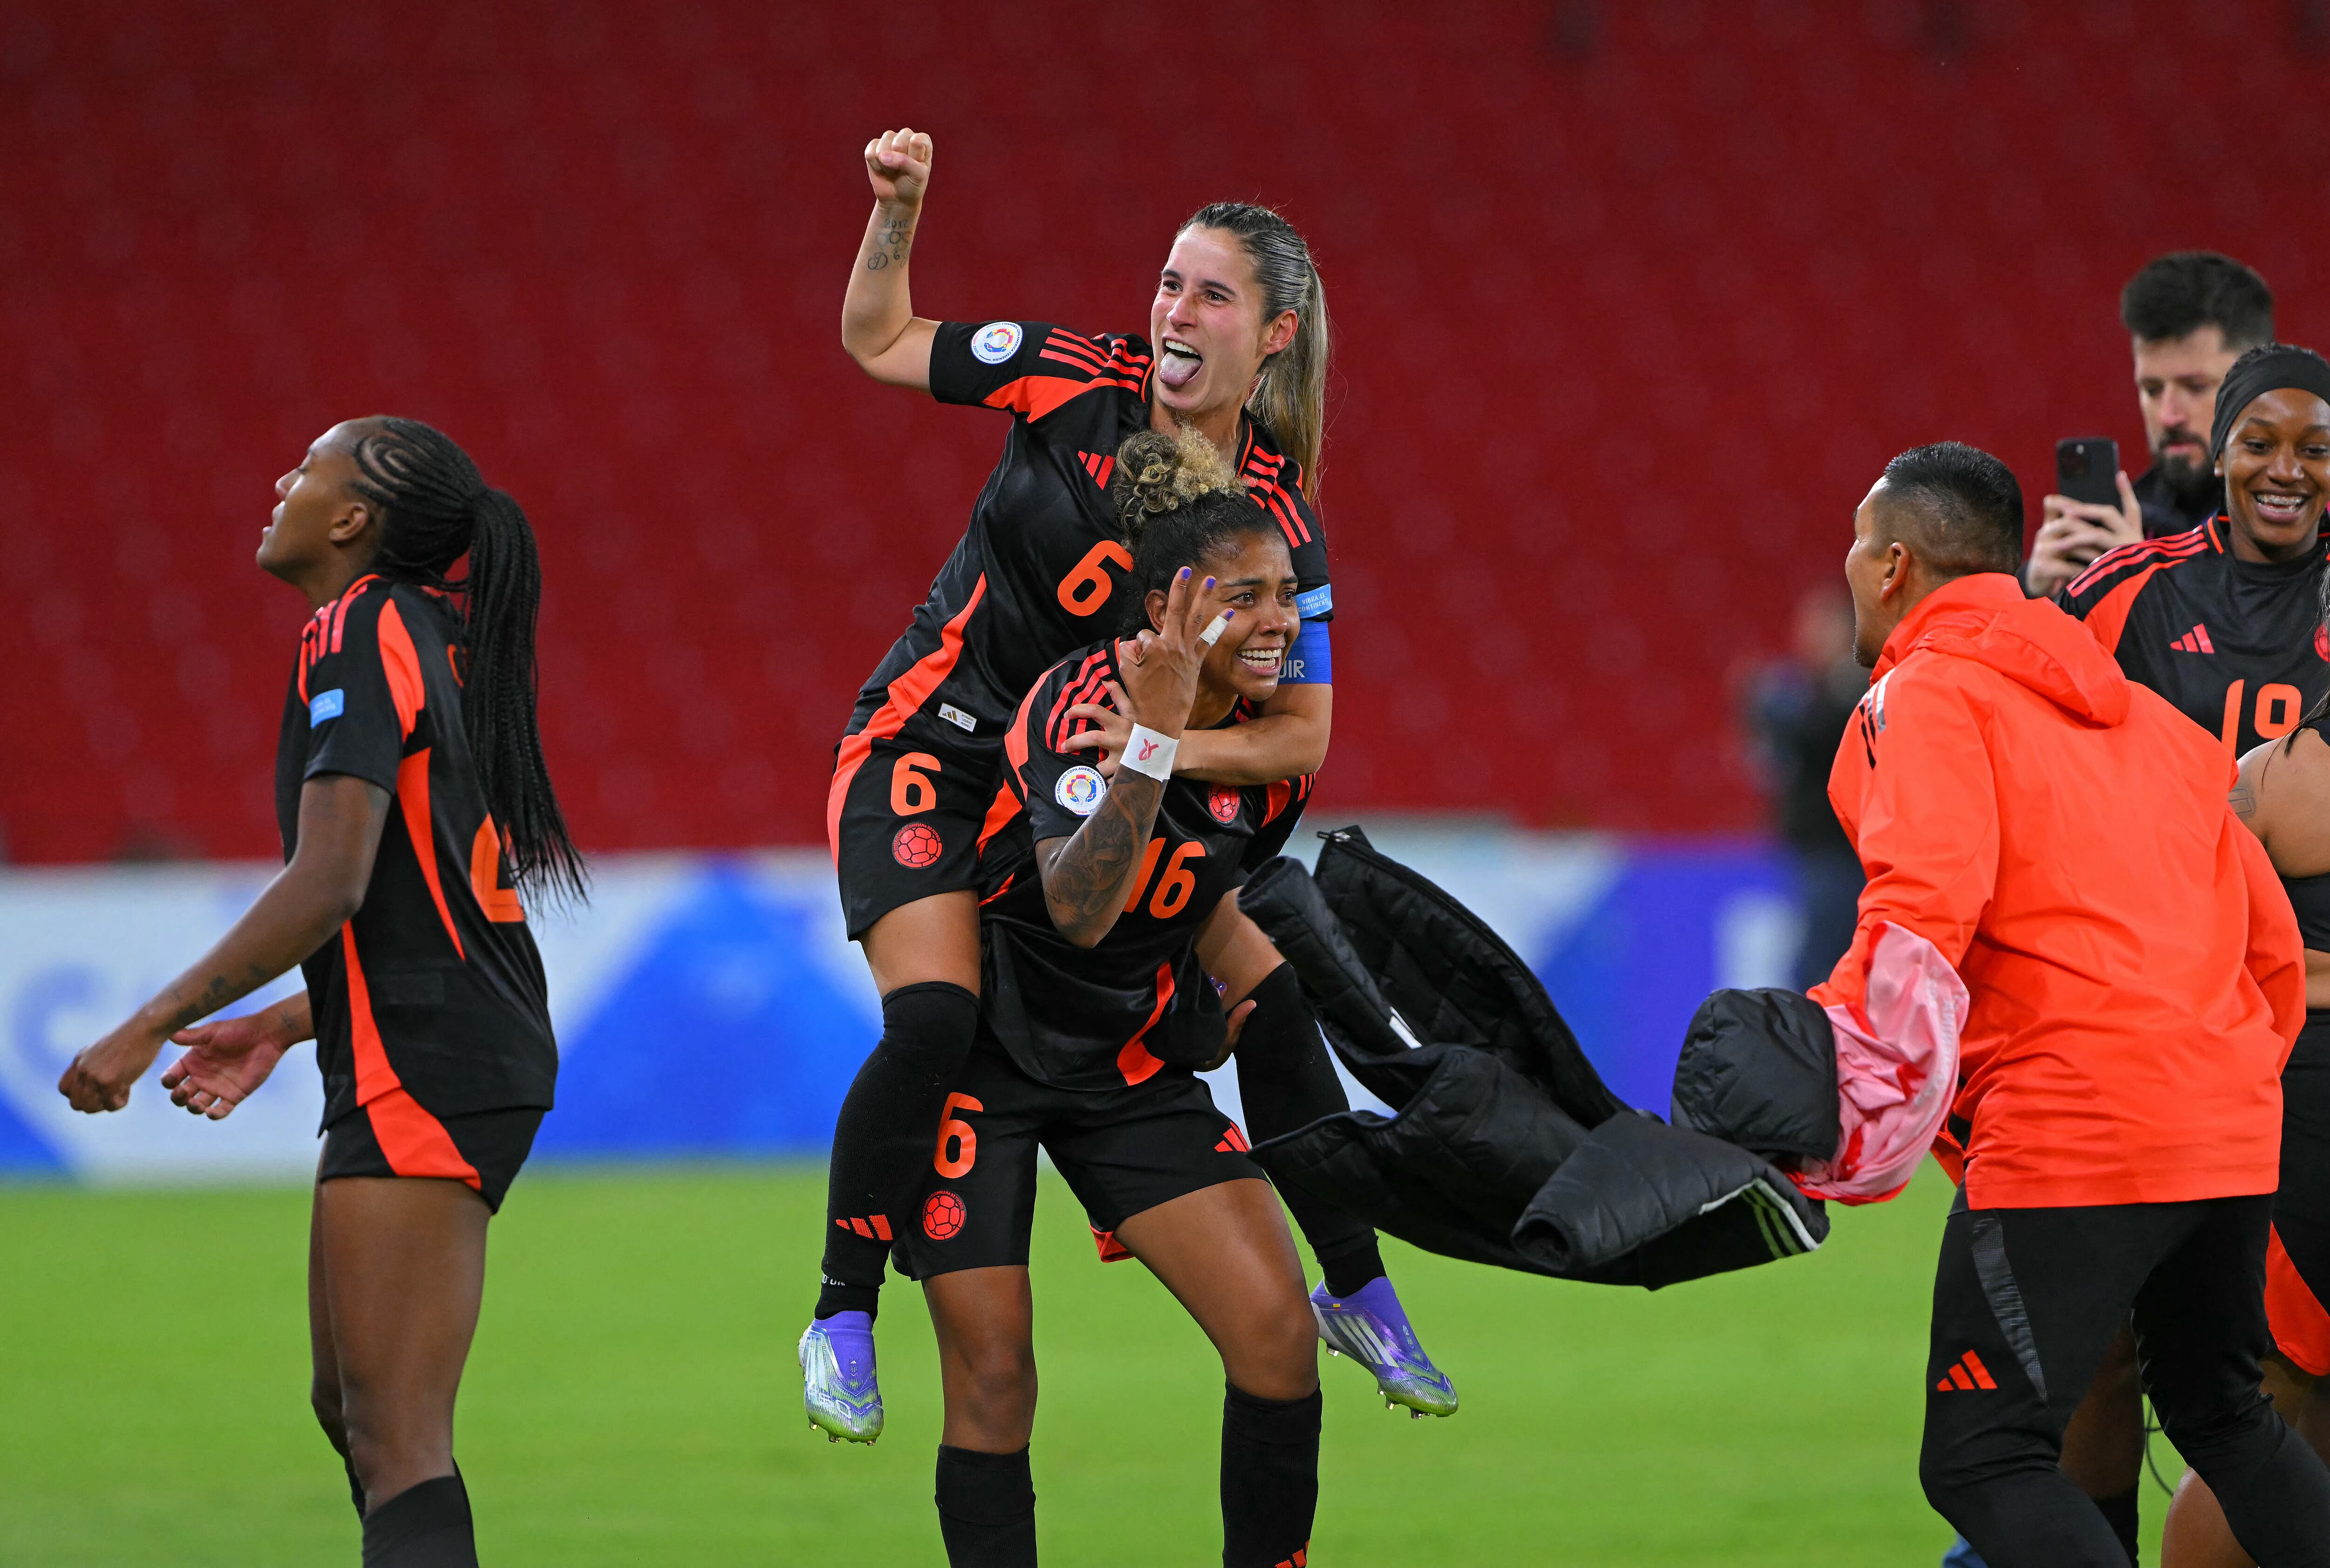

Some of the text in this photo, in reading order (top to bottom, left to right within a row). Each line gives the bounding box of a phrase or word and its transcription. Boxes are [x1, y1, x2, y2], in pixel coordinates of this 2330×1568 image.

[992, 351, 1012, 362] FEMENINA
[1057, 540, 1134, 616] 6
[1298, 598, 1329, 612] CONTINENTE
[1302, 595, 1319, 604] VIBRA
[891, 752, 941, 816] 6
[1057, 774, 1068, 794] CONMEBOL
[1078, 767, 1096, 775] AMERICA
[1095, 774, 1105, 794] FEMENINA
[932, 829, 941, 842] FUTBOL
[1123, 837, 1206, 919] 16
[933, 1092, 983, 1178] 6
[954, 1197, 964, 1210] FUTBOL
